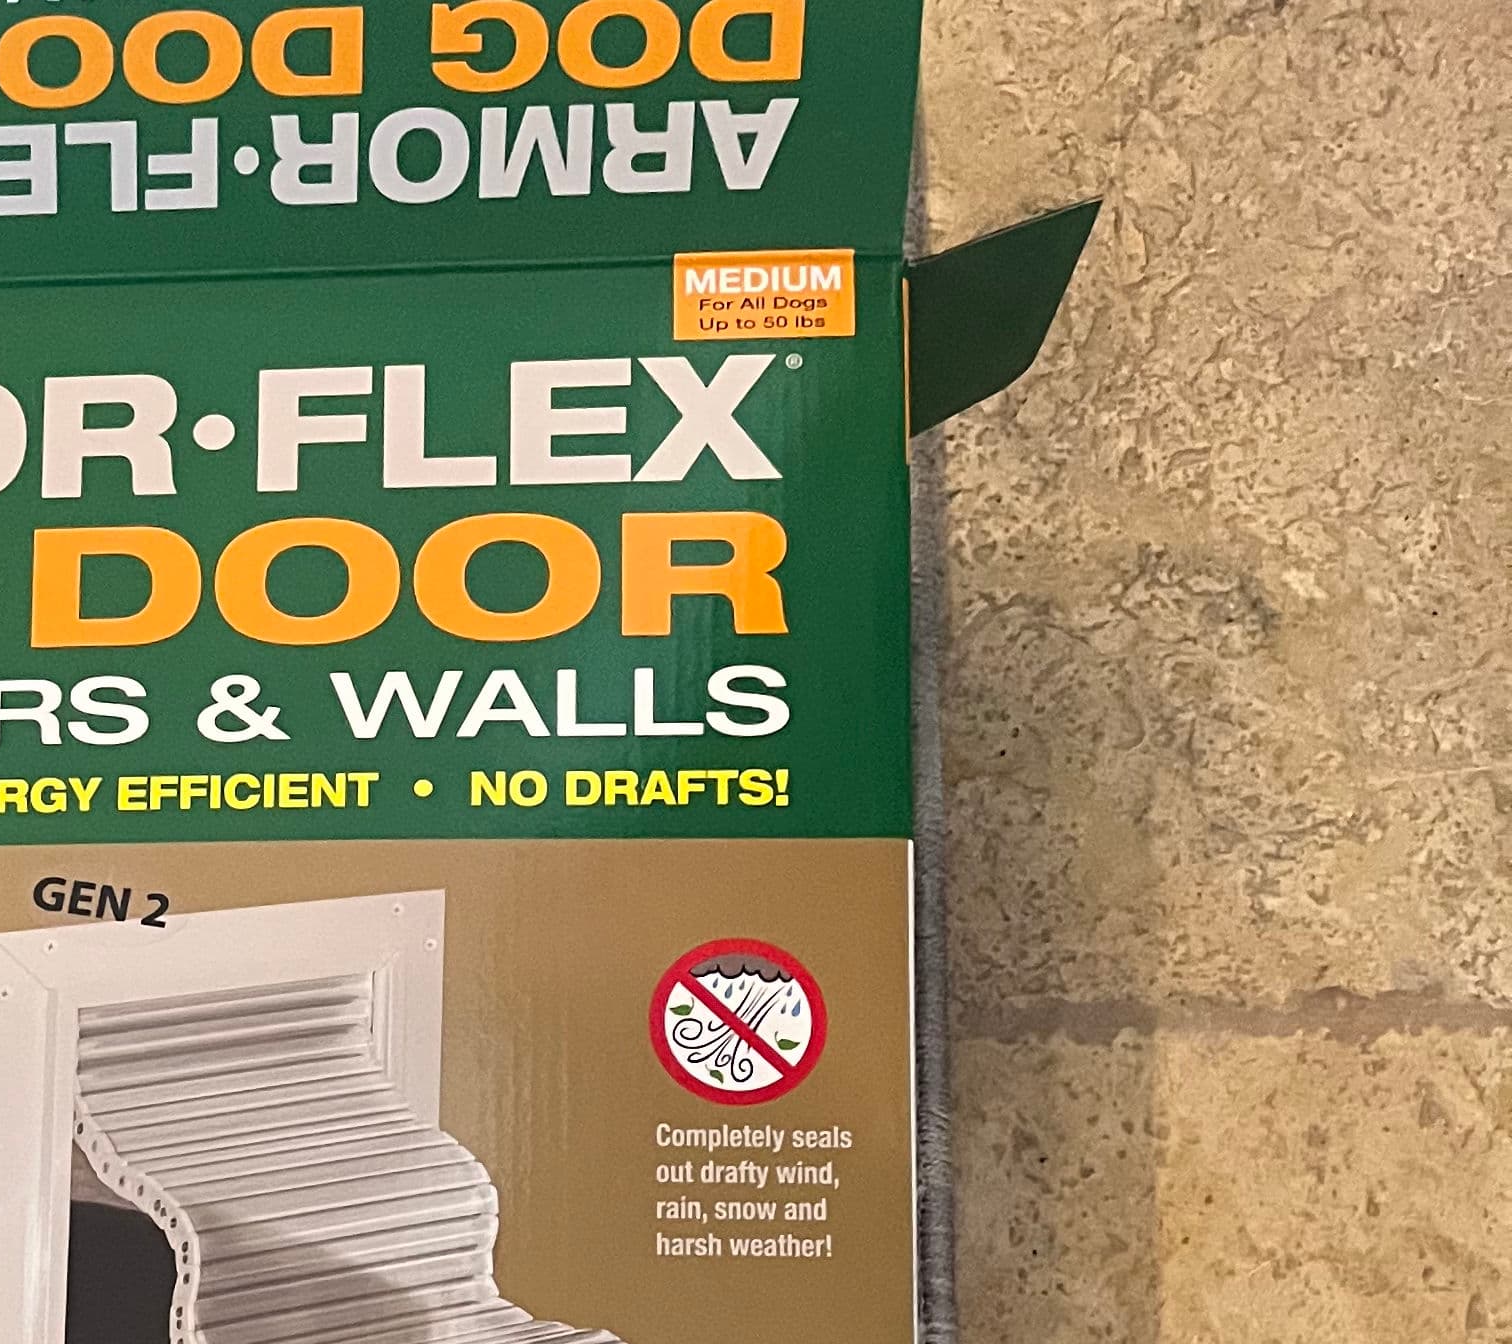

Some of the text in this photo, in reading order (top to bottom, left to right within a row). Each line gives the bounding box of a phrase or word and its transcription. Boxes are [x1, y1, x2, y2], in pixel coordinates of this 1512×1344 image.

[432, 0, 804, 91] DOG
[685, 266, 842, 294] MEDIUM
[699, 297, 827, 311] For All Dogs
[699, 316, 826, 332] Up to 50 lbs
[30, 511, 790, 648] DOOR
[196, 674, 292, 743] &
[329, 666, 792, 740] WALLS
[116, 773, 380, 811] EFFICIENT
[469, 771, 550, 806] NO
[566, 768, 792, 807] DRAFTS!
[32, 875, 171, 928] GEN 2
[655, 1123, 853, 1154] Completely seals
[655, 1160, 840, 1190] out drafty wind,
[655, 1197, 828, 1224] rain, snow and
[655, 1233, 833, 1258] harsh weather!
